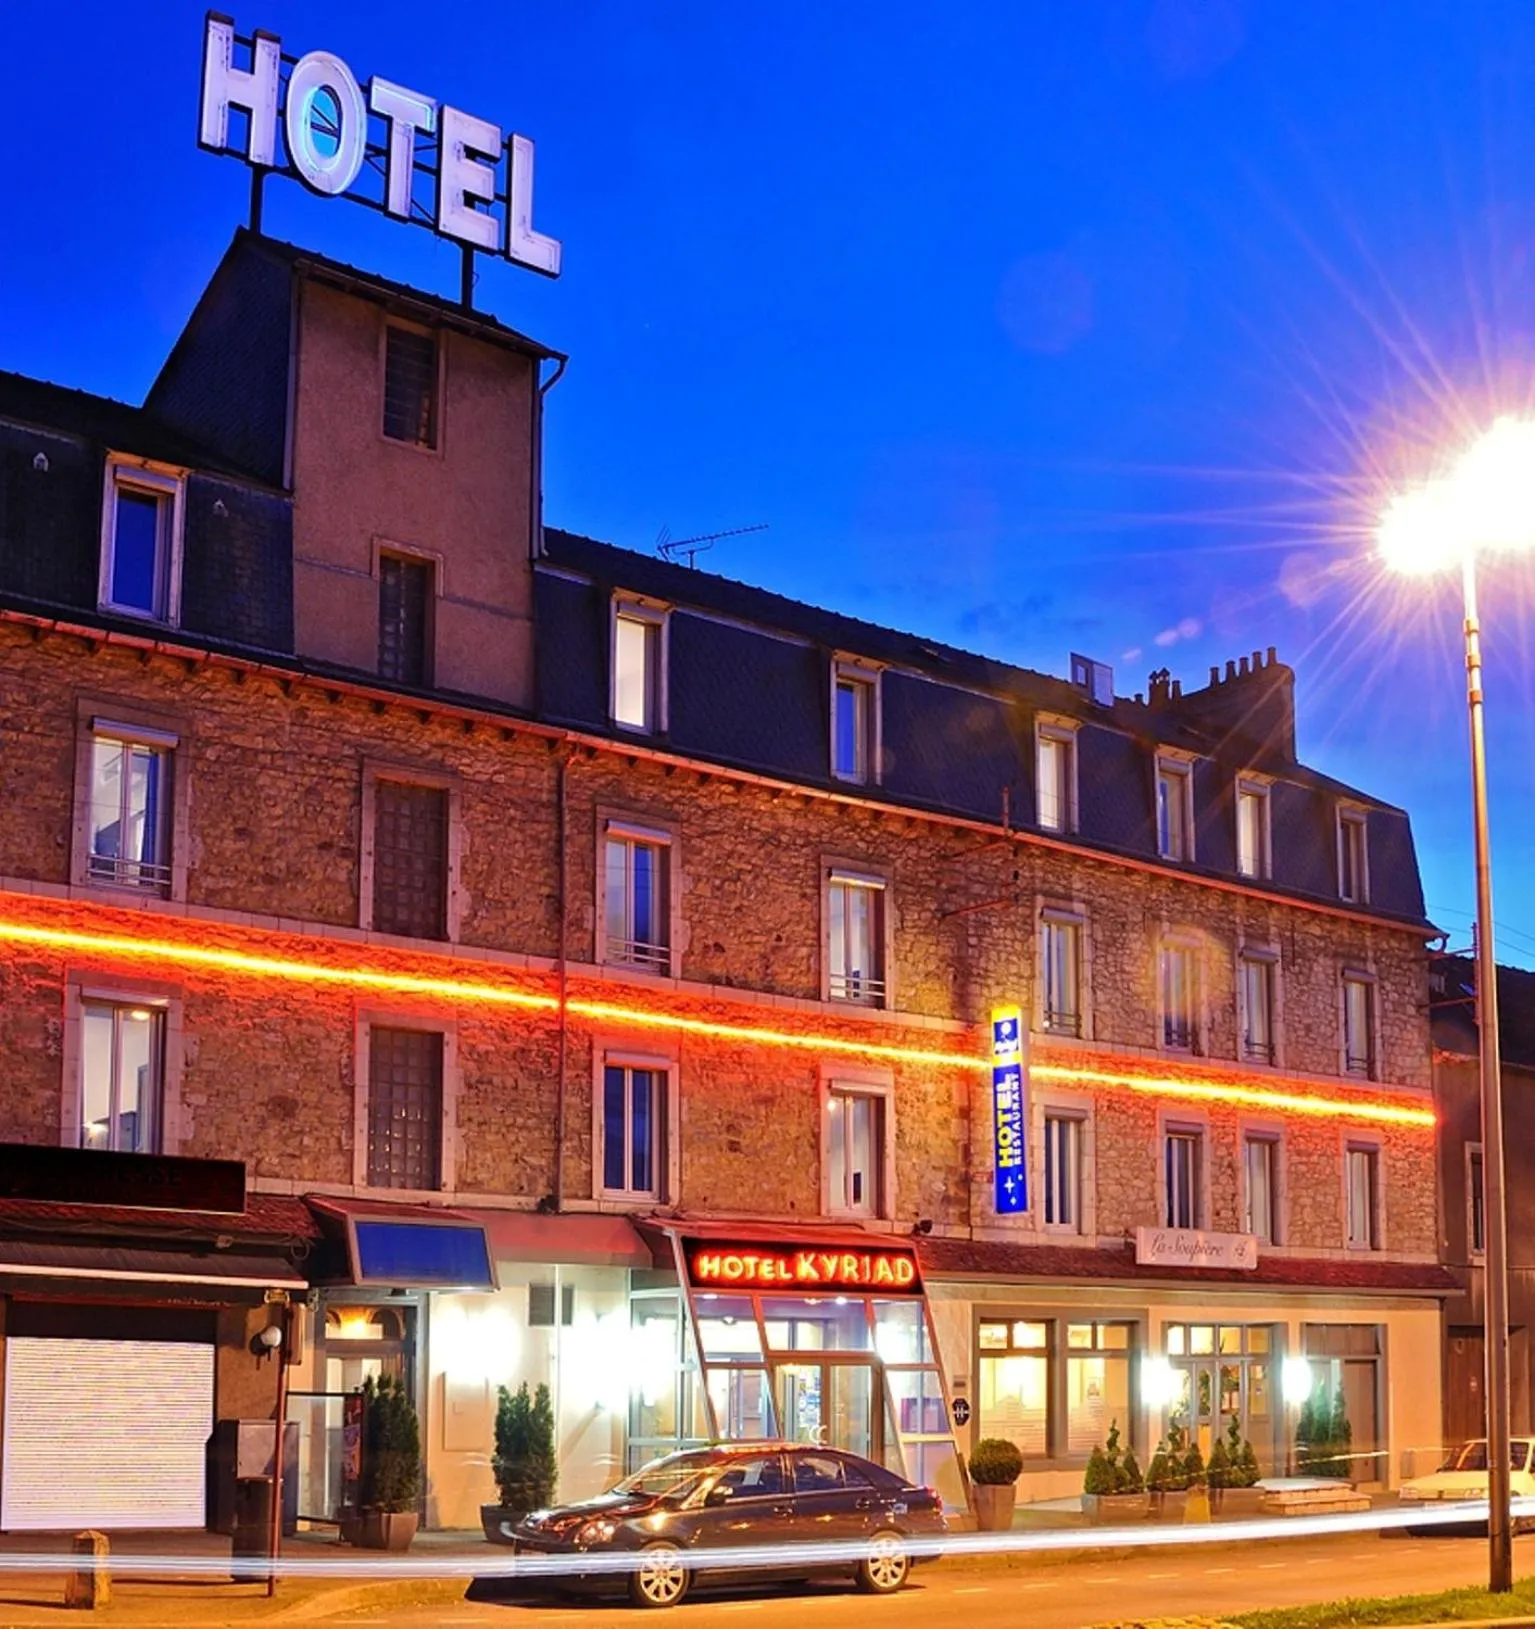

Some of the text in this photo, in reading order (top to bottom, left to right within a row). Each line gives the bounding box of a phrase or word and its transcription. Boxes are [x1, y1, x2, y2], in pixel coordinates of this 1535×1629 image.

[198, 9, 562, 278] HOTEL
[997, 1073, 1013, 1167] HOTEL
[1011, 1073, 1022, 1165] RESTAURANT
[700, 1252, 913, 1282] HOTEL KYRIAD
